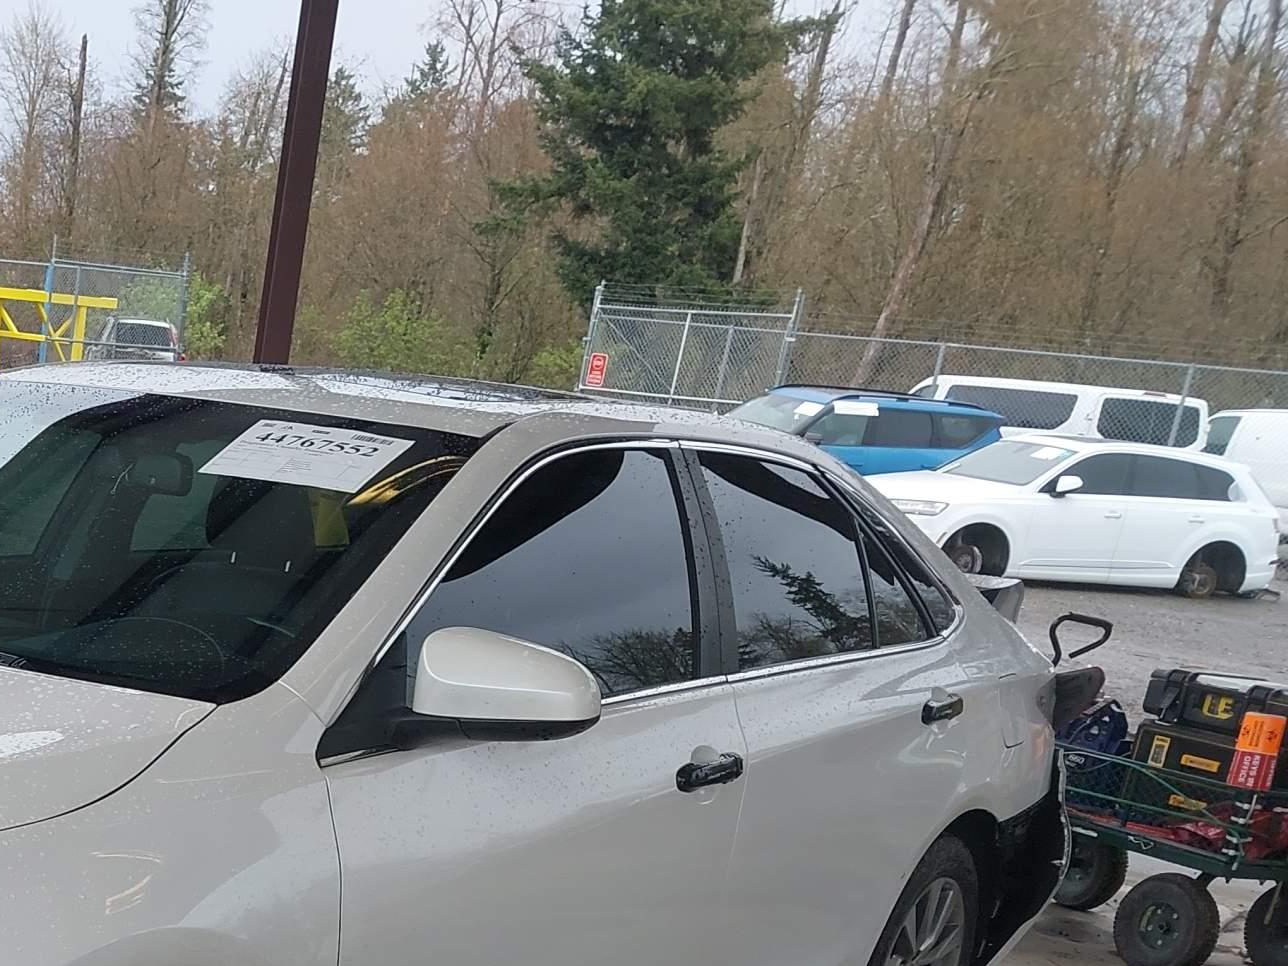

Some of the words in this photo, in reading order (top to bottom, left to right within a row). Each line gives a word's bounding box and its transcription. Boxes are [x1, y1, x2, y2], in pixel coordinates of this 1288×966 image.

[256, 432, 380, 457] 44767552
[1238, 755, 1252, 783] OFFICE
[1249, 754, 1262, 776] KEYS
